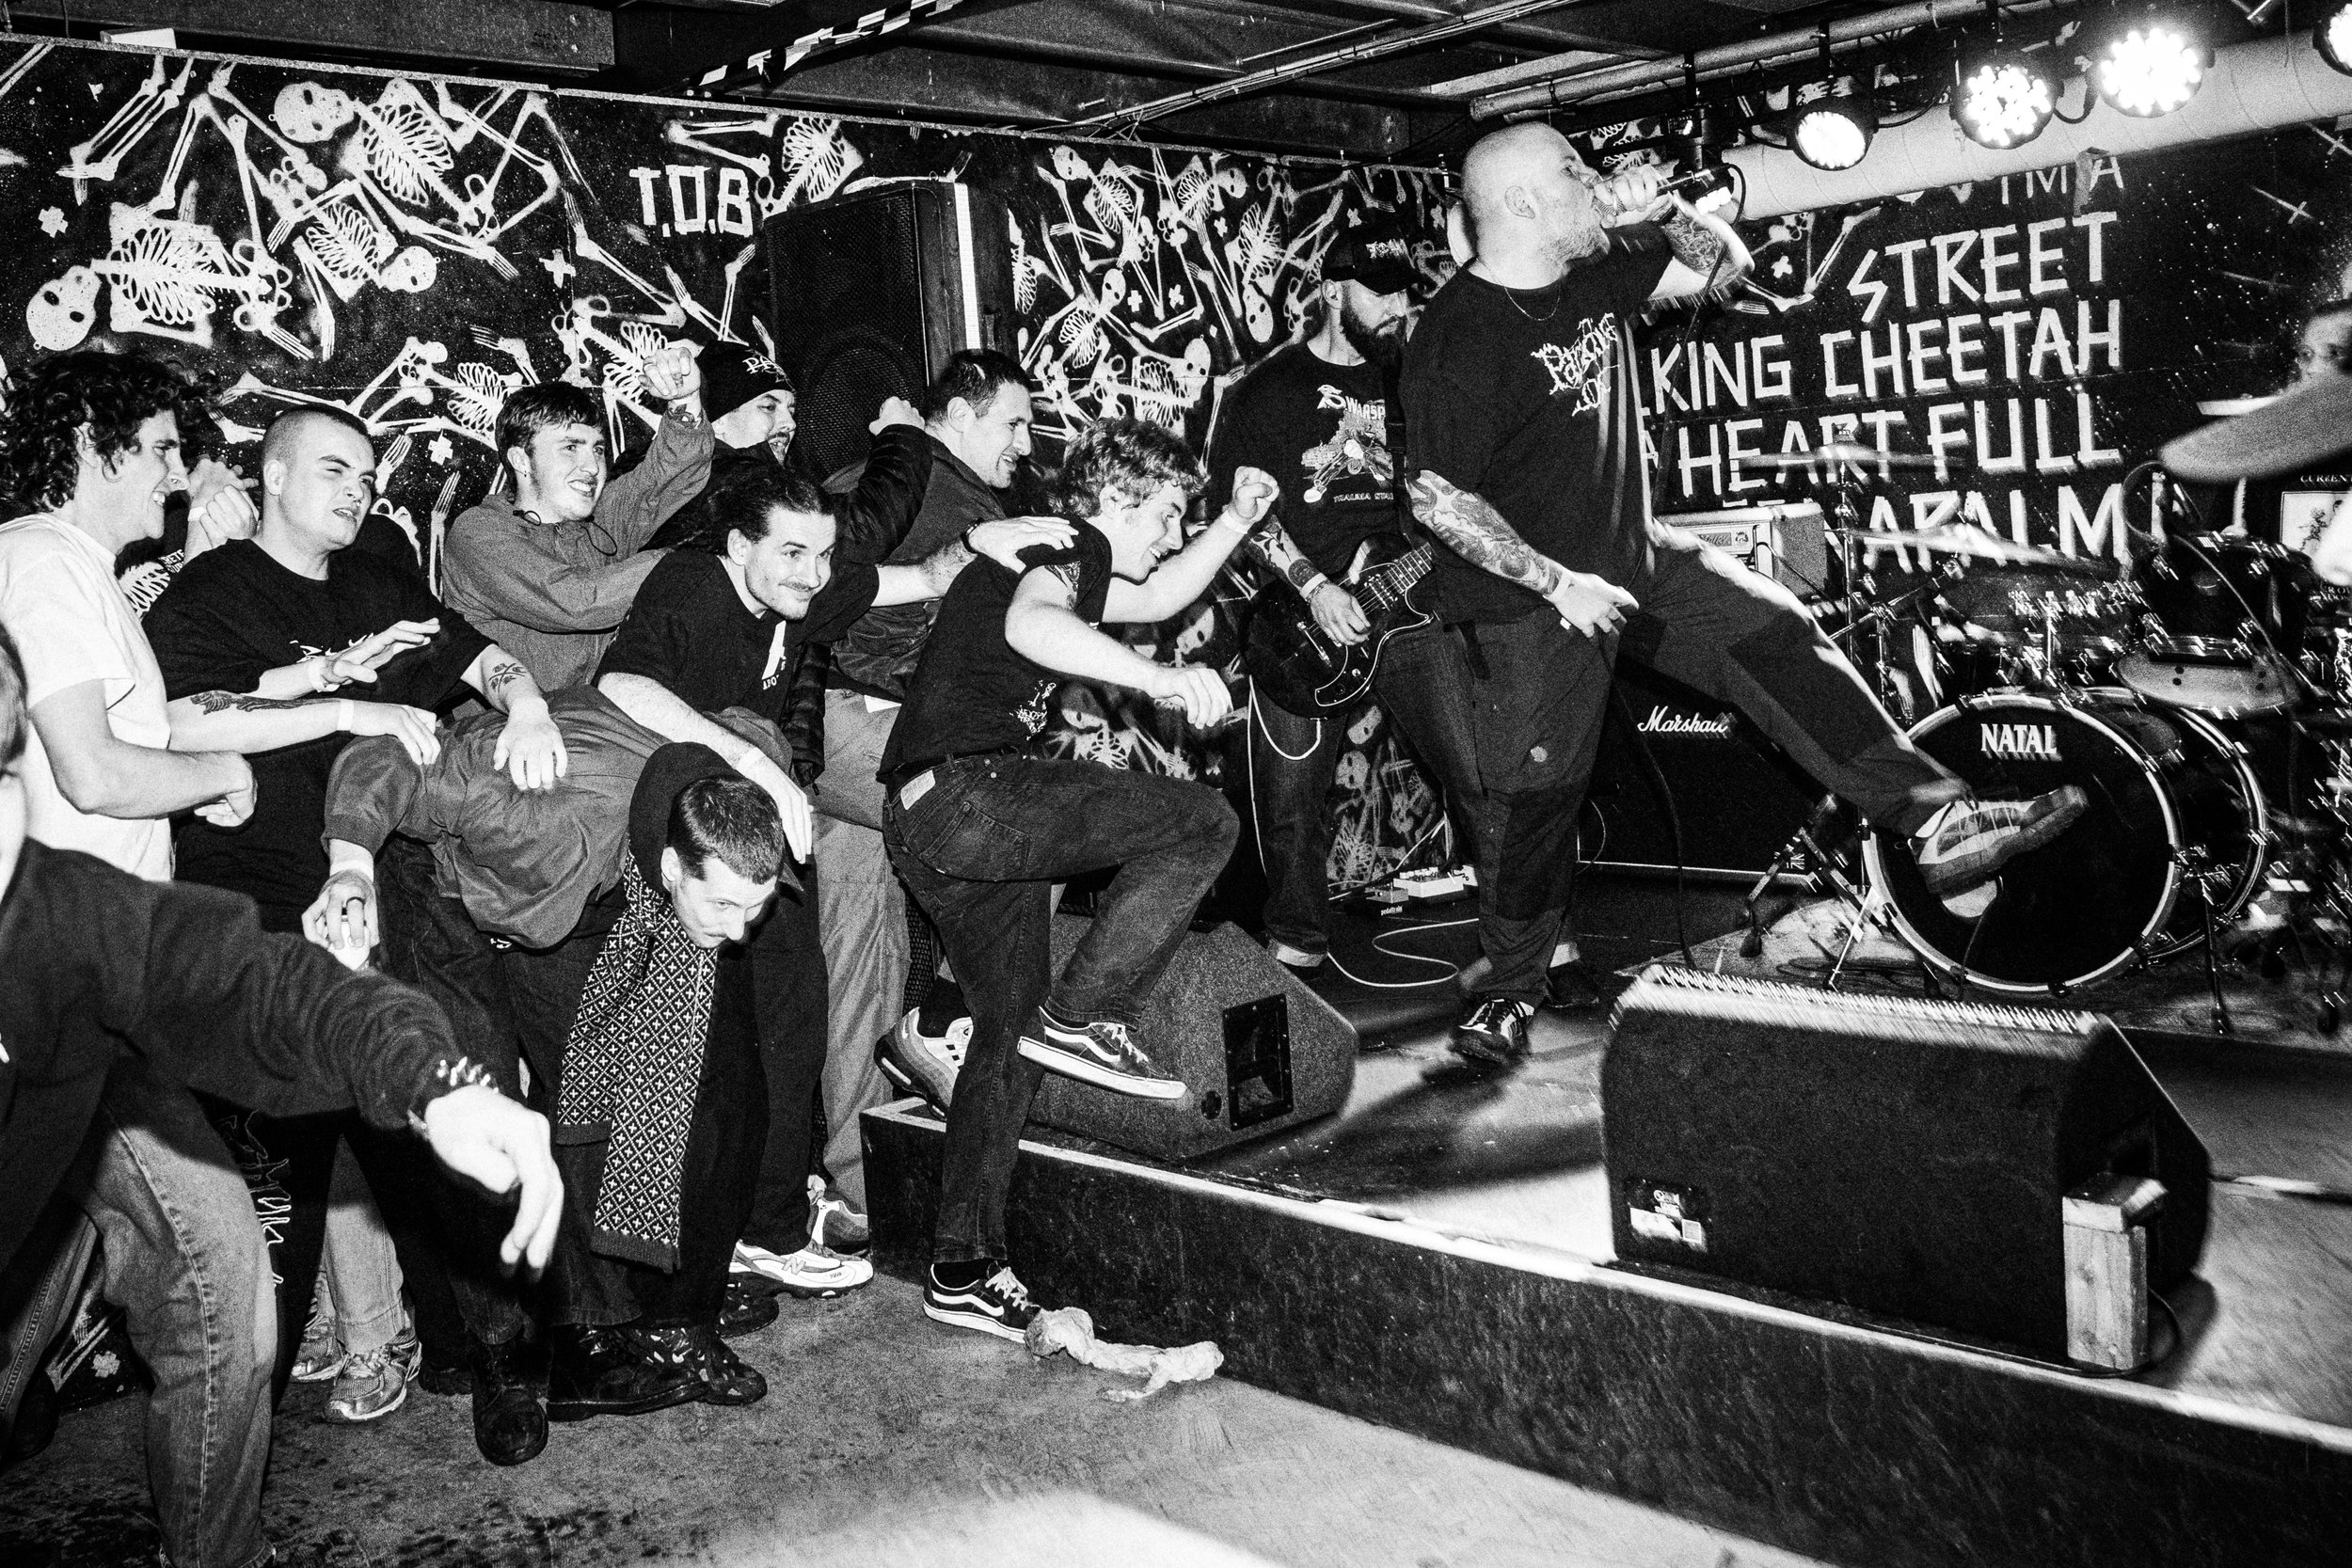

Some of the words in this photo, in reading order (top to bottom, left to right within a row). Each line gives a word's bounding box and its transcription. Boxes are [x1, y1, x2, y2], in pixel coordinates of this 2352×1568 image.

[1849, 211, 2118, 323] STREET
[1820, 299, 2122, 397] CHEETAH
[1678, 410, 1904, 498] HEART
[1928, 393, 2122, 483] FULL
[2300, 475, 2352, 483] CURREN
[1637, 705, 1734, 736] Marshall
[1980, 722, 2058, 755] NATAL
